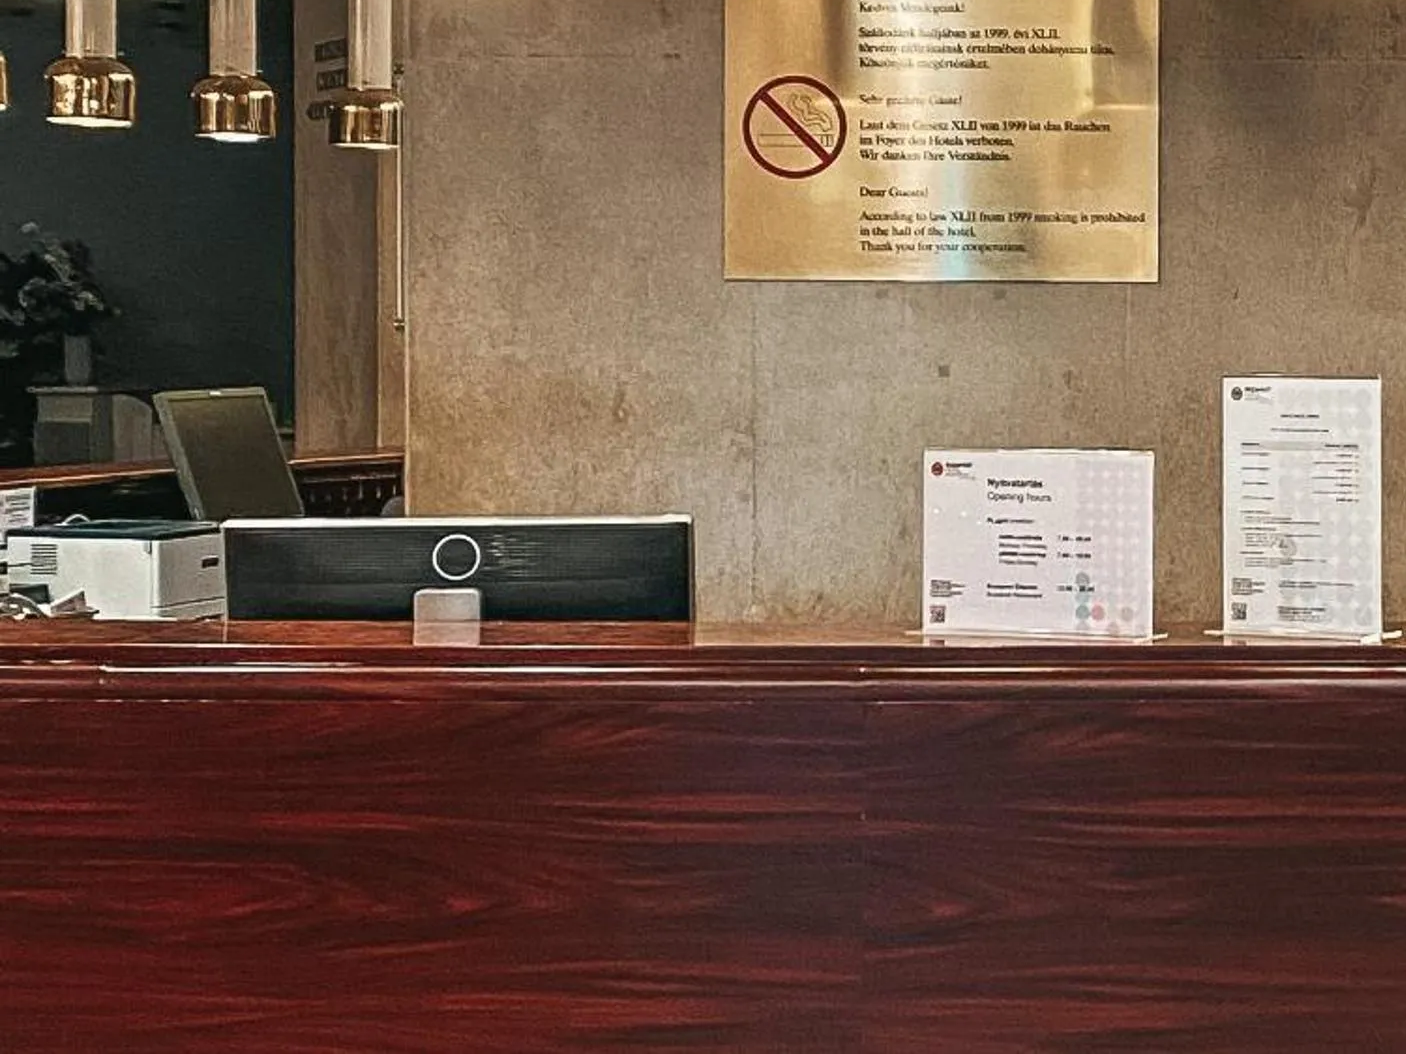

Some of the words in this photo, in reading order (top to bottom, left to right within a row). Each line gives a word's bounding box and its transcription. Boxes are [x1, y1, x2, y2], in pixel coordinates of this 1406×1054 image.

[859, 119, 884, 131] Laut
[1002, 120, 1027, 131] 1999
[1064, 120, 1111, 132] Rauchen
[929, 135, 964, 146] Hotels
[859, 149, 880, 161] Wir
[859, 186, 887, 197] Dear
[859, 211, 914, 223] According
[916, 211, 927, 221] to
[979, 211, 1005, 222] from
[1008, 211, 1033, 223] 1999
[1034, 211, 1078, 224] smoking
[1080, 211, 1089, 222] is
[1090, 211, 1146, 224] prohibited
[859, 226, 871, 236] in
[872, 226, 889, 236] the
[891, 226, 912, 236] hall
[914, 226, 926, 236] of
[927, 226, 945, 236] the
[859, 240, 893, 251] Thank
[895, 242, 915, 254] you
[917, 240, 934, 251] for
[986, 491, 1025, 504] Opening
[1026, 492, 1053, 503] hours
